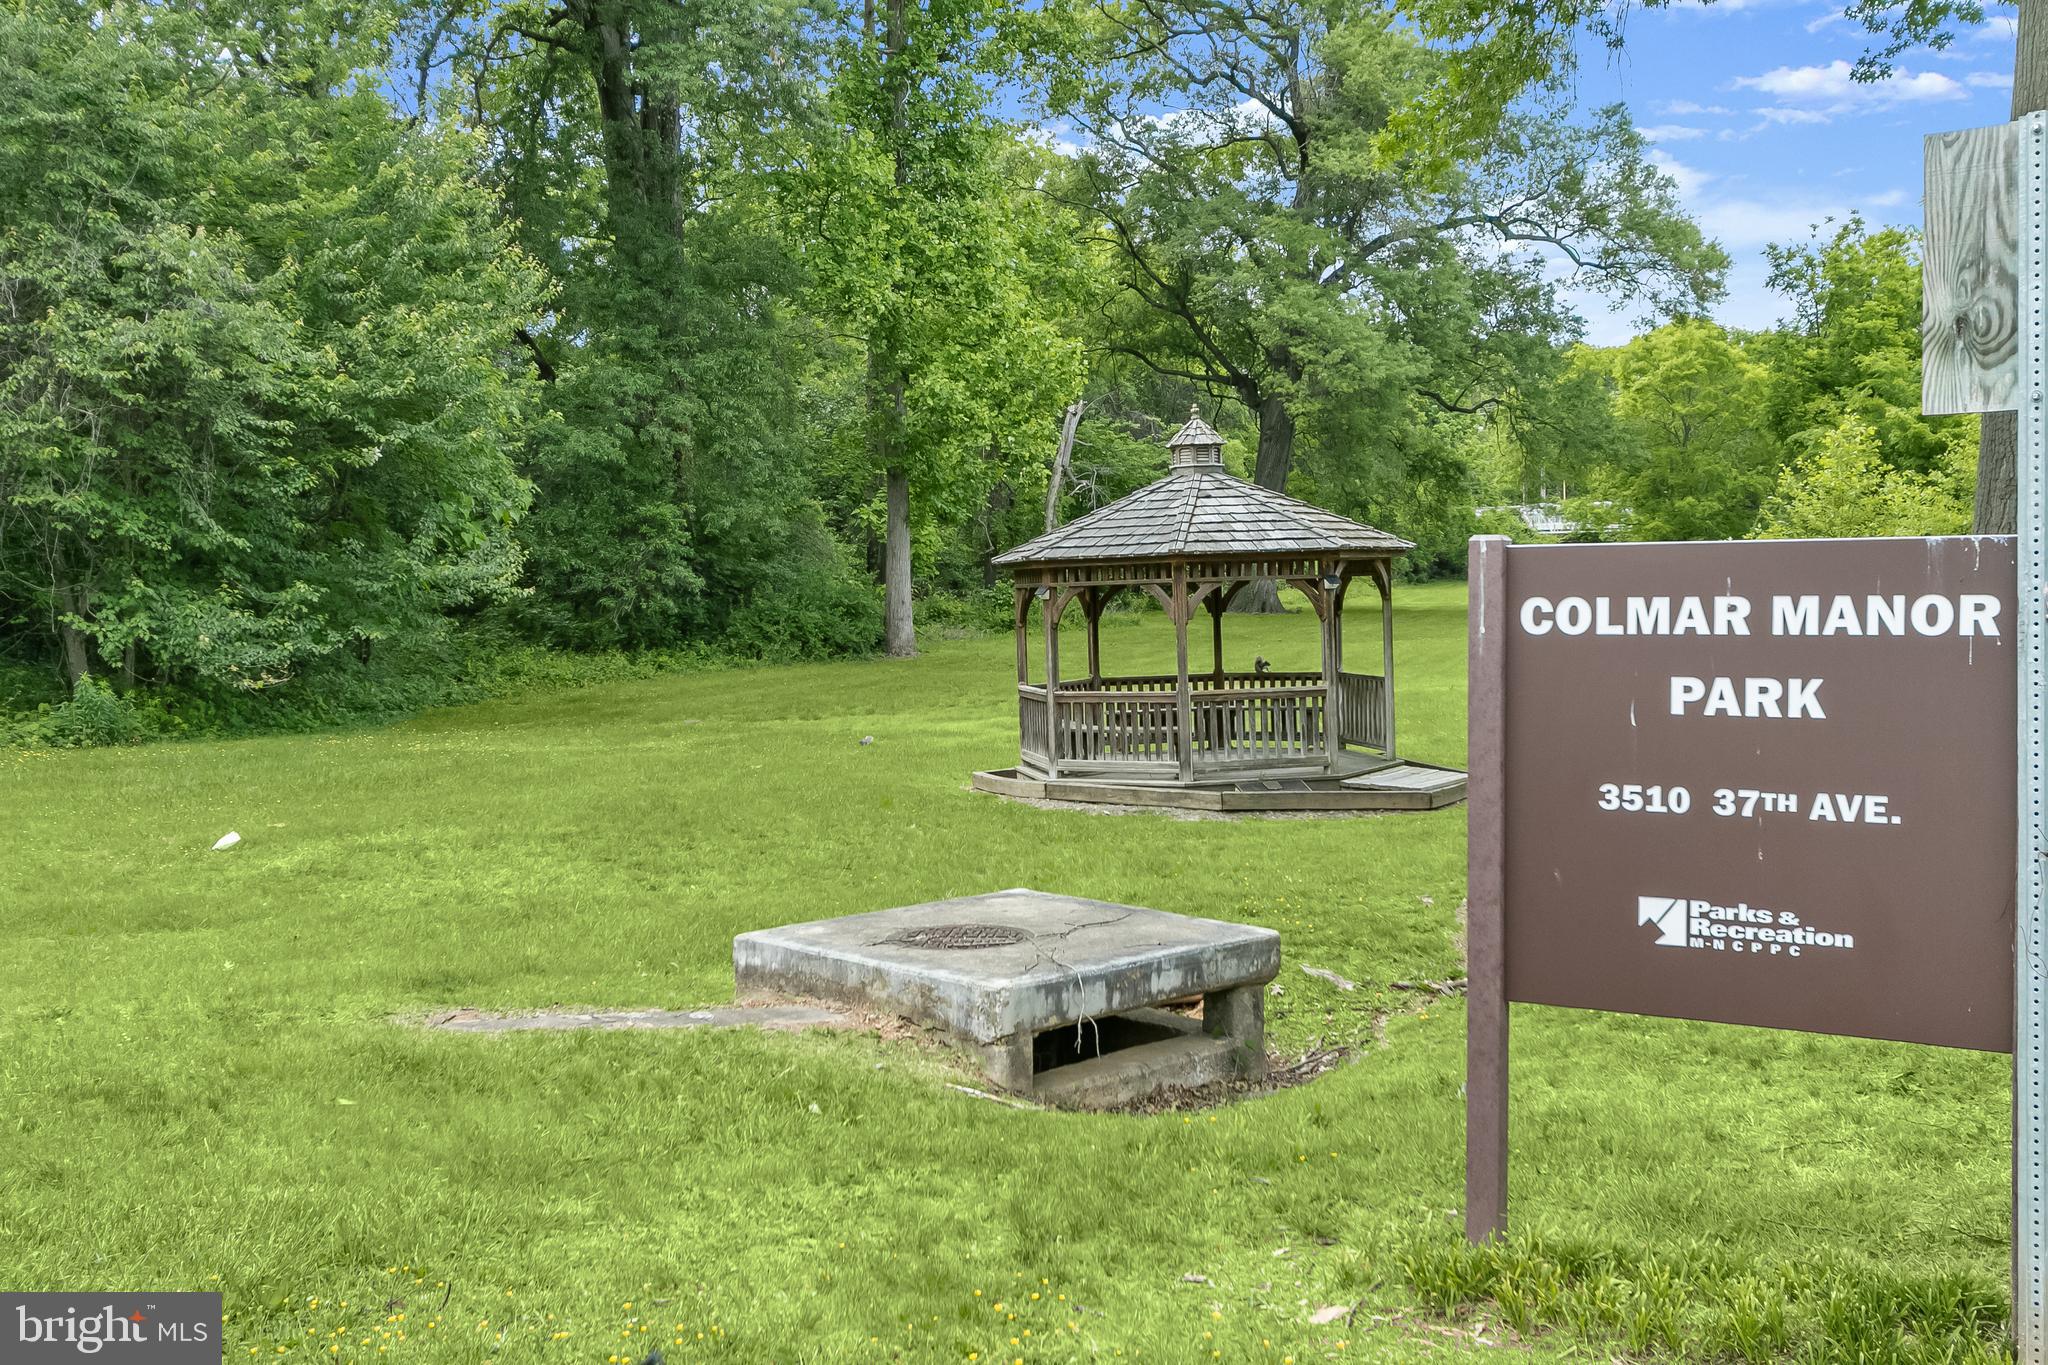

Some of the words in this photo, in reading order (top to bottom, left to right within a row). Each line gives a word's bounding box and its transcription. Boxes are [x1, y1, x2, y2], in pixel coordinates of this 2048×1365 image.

[1519, 595, 1752, 637] COLMAR
[1771, 593, 2002, 638] MANOR
[1669, 675, 1828, 720] PARK
[1597, 783, 1692, 815] 3510
[1712, 788, 1799, 817] 37TH
[1808, 792, 1903, 826] AVE.
[1688, 916, 1855, 949] Recreation
[1689, 899, 1774, 925] Parks
[1777, 910, 1801, 927] &
